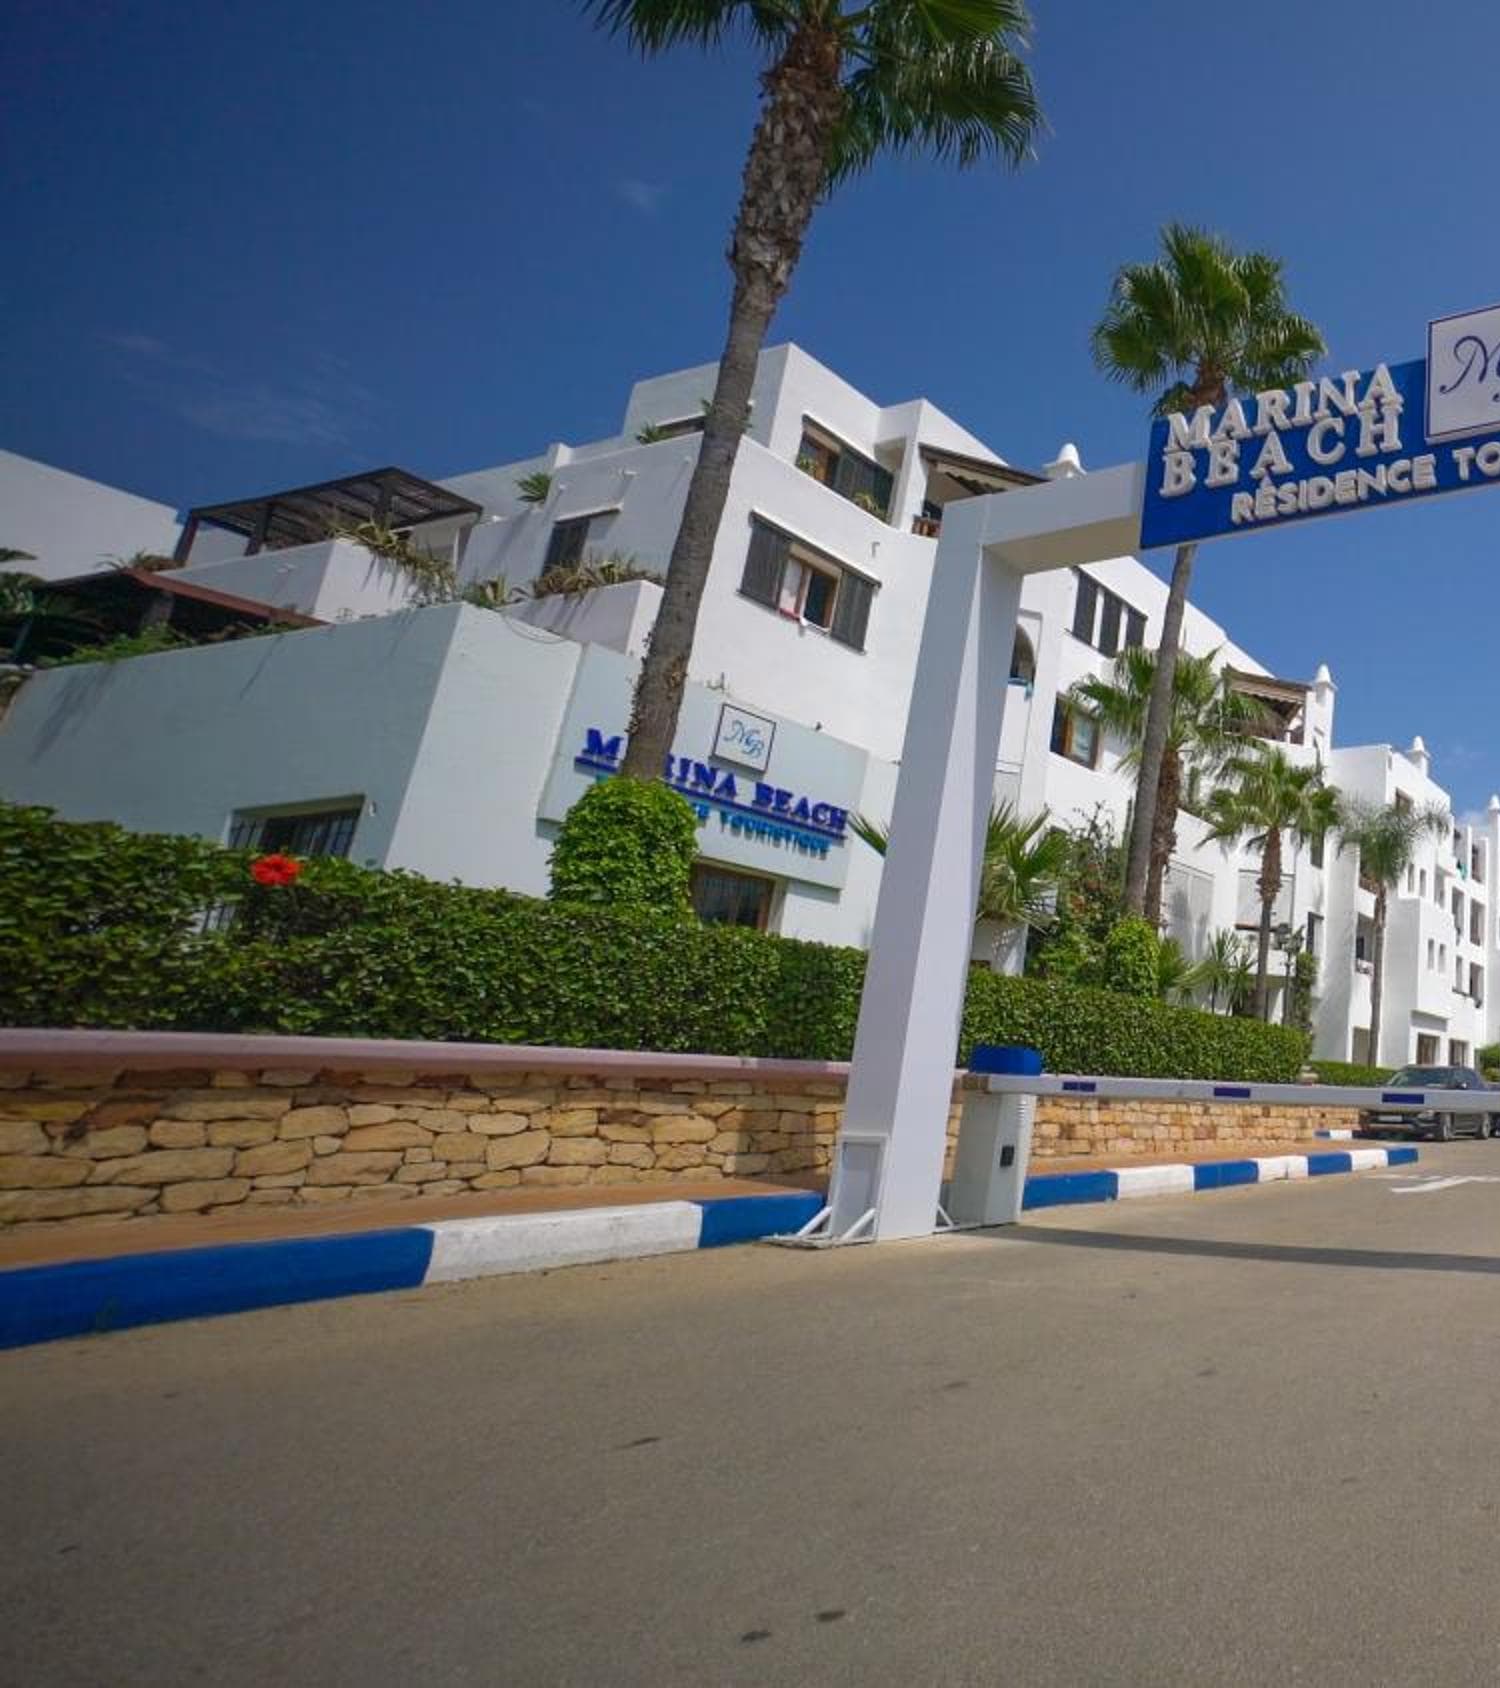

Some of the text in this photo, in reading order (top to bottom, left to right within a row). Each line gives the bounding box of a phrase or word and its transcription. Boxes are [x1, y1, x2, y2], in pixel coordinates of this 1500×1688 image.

[1159, 397, 1403, 497] BEACH
[1163, 363, 1403, 452] MARINA
[1231, 453, 1437, 524] RÉSIDENCE
[581, 728, 738, 797] MINA
[751, 782, 849, 831] BEACH
